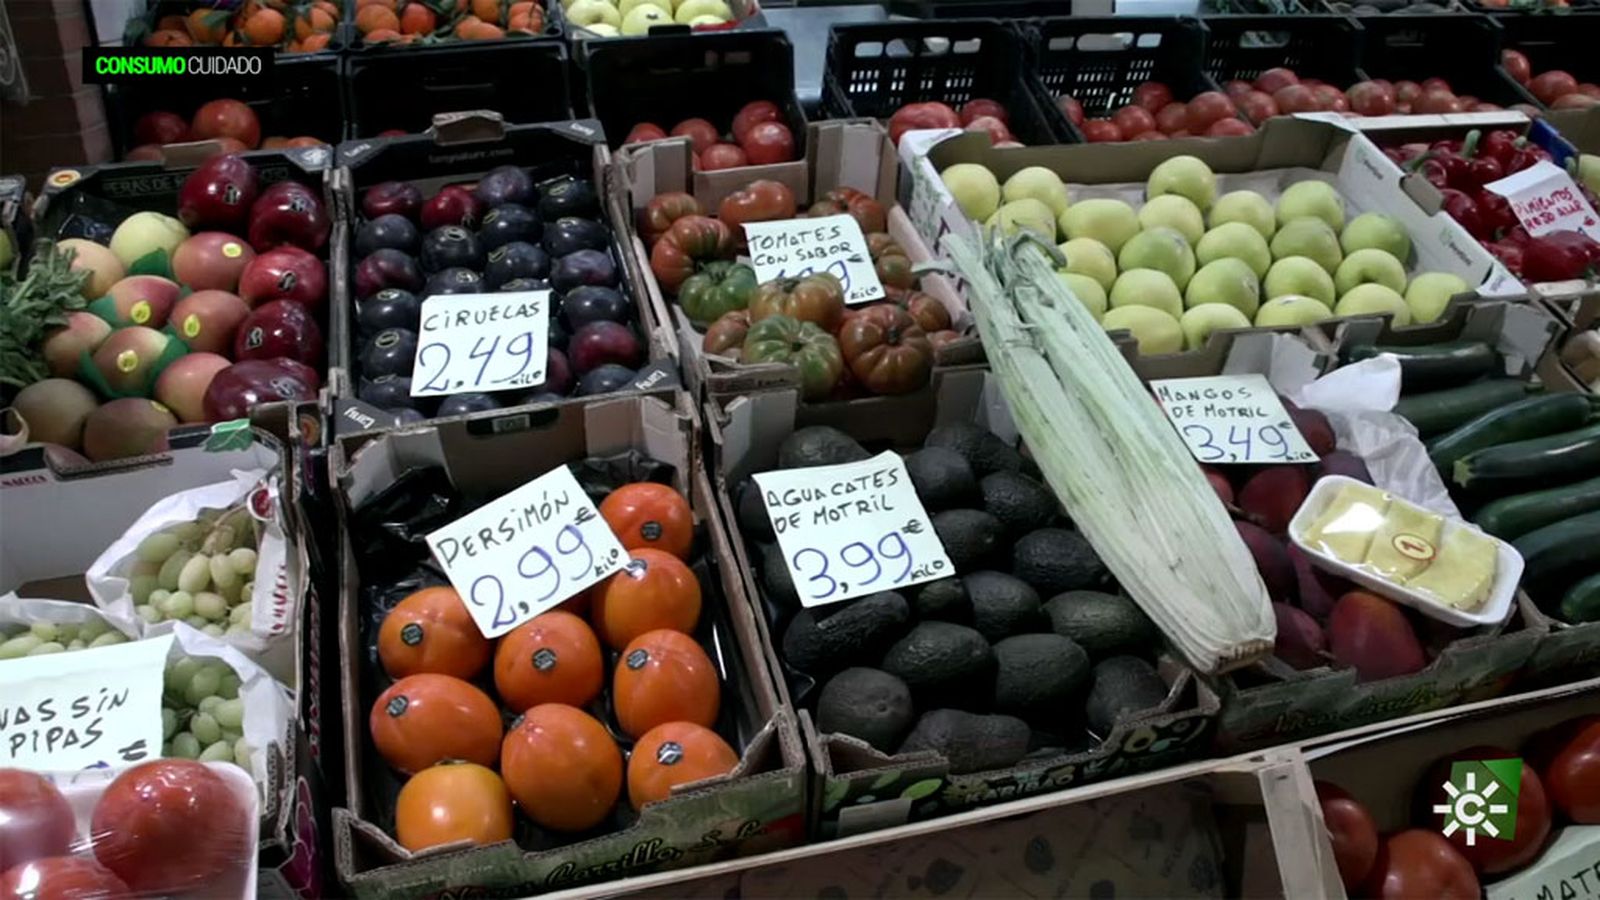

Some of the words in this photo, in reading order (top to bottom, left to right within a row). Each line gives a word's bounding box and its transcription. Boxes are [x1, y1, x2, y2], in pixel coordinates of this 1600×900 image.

[754, 254, 789, 267] CON
[796, 241, 854, 261] SABOR
[1157, 386, 1252, 402] MANGOS
[1172, 405, 1196, 419] DE
[766, 467, 899, 508] AGUACATES
[774, 511, 801, 534] DE
[9, 716, 103, 759] PIPAS
